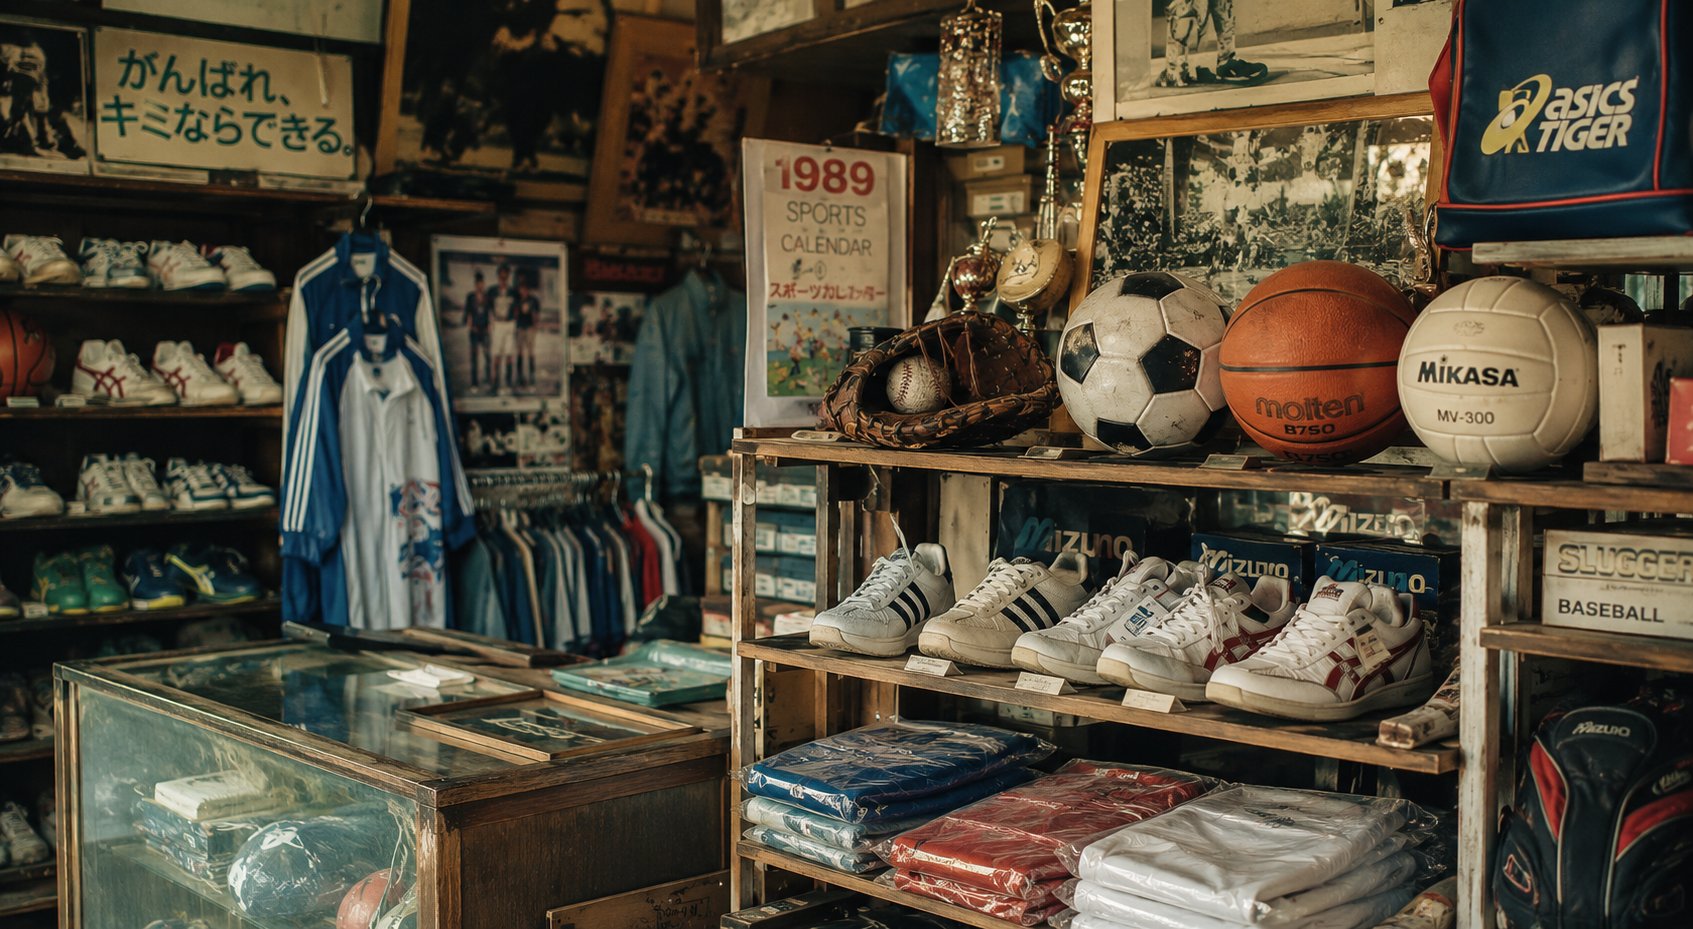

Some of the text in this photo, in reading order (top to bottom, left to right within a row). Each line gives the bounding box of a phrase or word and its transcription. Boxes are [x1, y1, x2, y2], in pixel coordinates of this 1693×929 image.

[117, 49, 290, 106] がんばれ、
[101, 95, 353, 156] キミならできる。
[1536, 113, 1632, 153] TIGER
[775, 155, 875, 196] 1989
[786, 200, 867, 227] SPORTS
[781, 233, 872, 256] CALENDAR
[1255, 392, 1366, 422] molten
[1437, 408, 1495, 425] MV-300
[1558, 598, 1665, 623] BASEBALL
